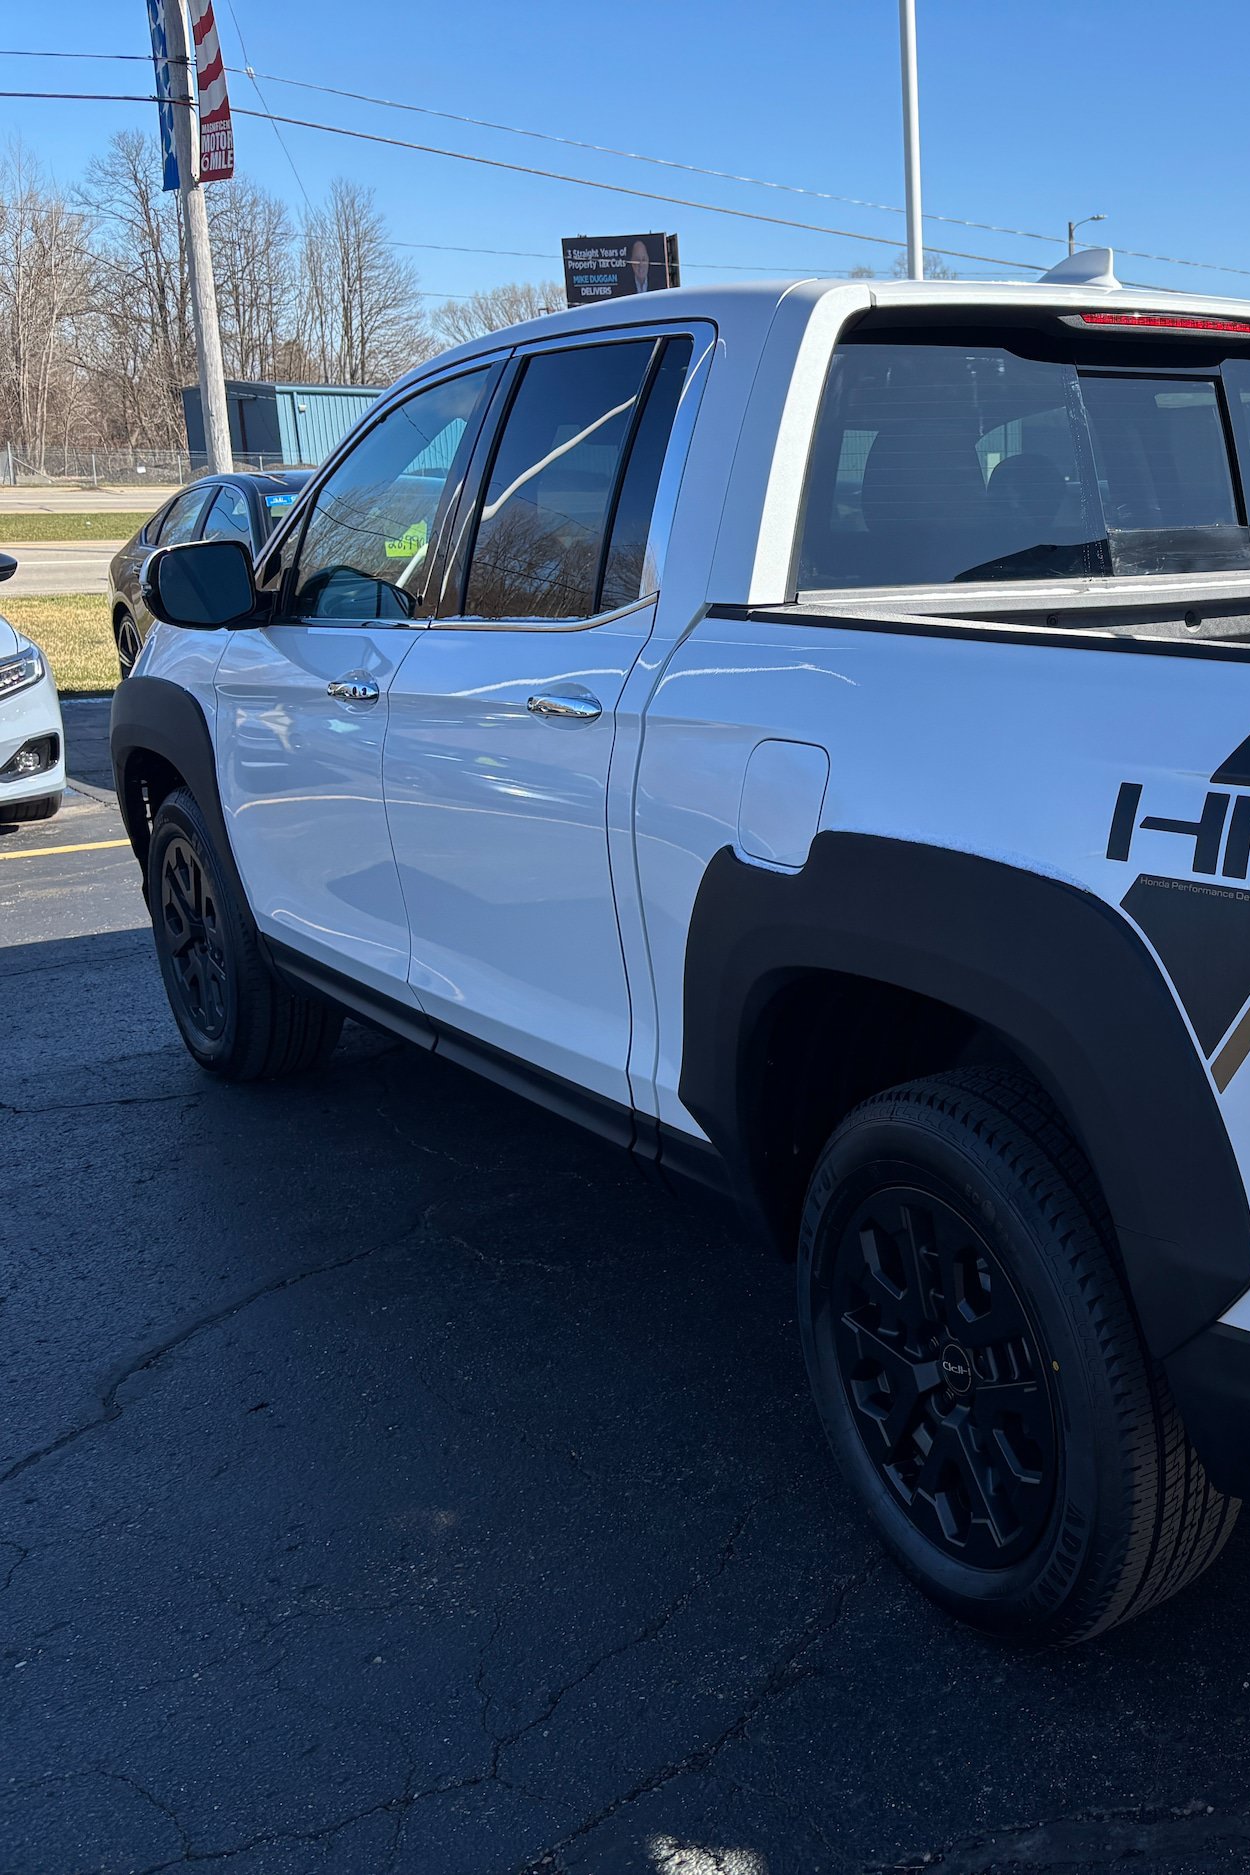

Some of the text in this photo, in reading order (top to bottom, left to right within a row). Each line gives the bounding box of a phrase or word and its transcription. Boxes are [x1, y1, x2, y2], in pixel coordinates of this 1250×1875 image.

[201, 130, 233, 153] MOTOR
[573, 248, 599, 259] Straight
[600, 248, 618, 257] Years
[619, 246, 627, 256] of
[568, 259, 626, 270] Property Tax Cuts
[573, 274, 618, 284] MIKE DUGGAN
[581, 287, 612, 296] DELIVERS
[1140, 876, 1170, 889] Honda
[1171, 881, 1234, 899] Performance
